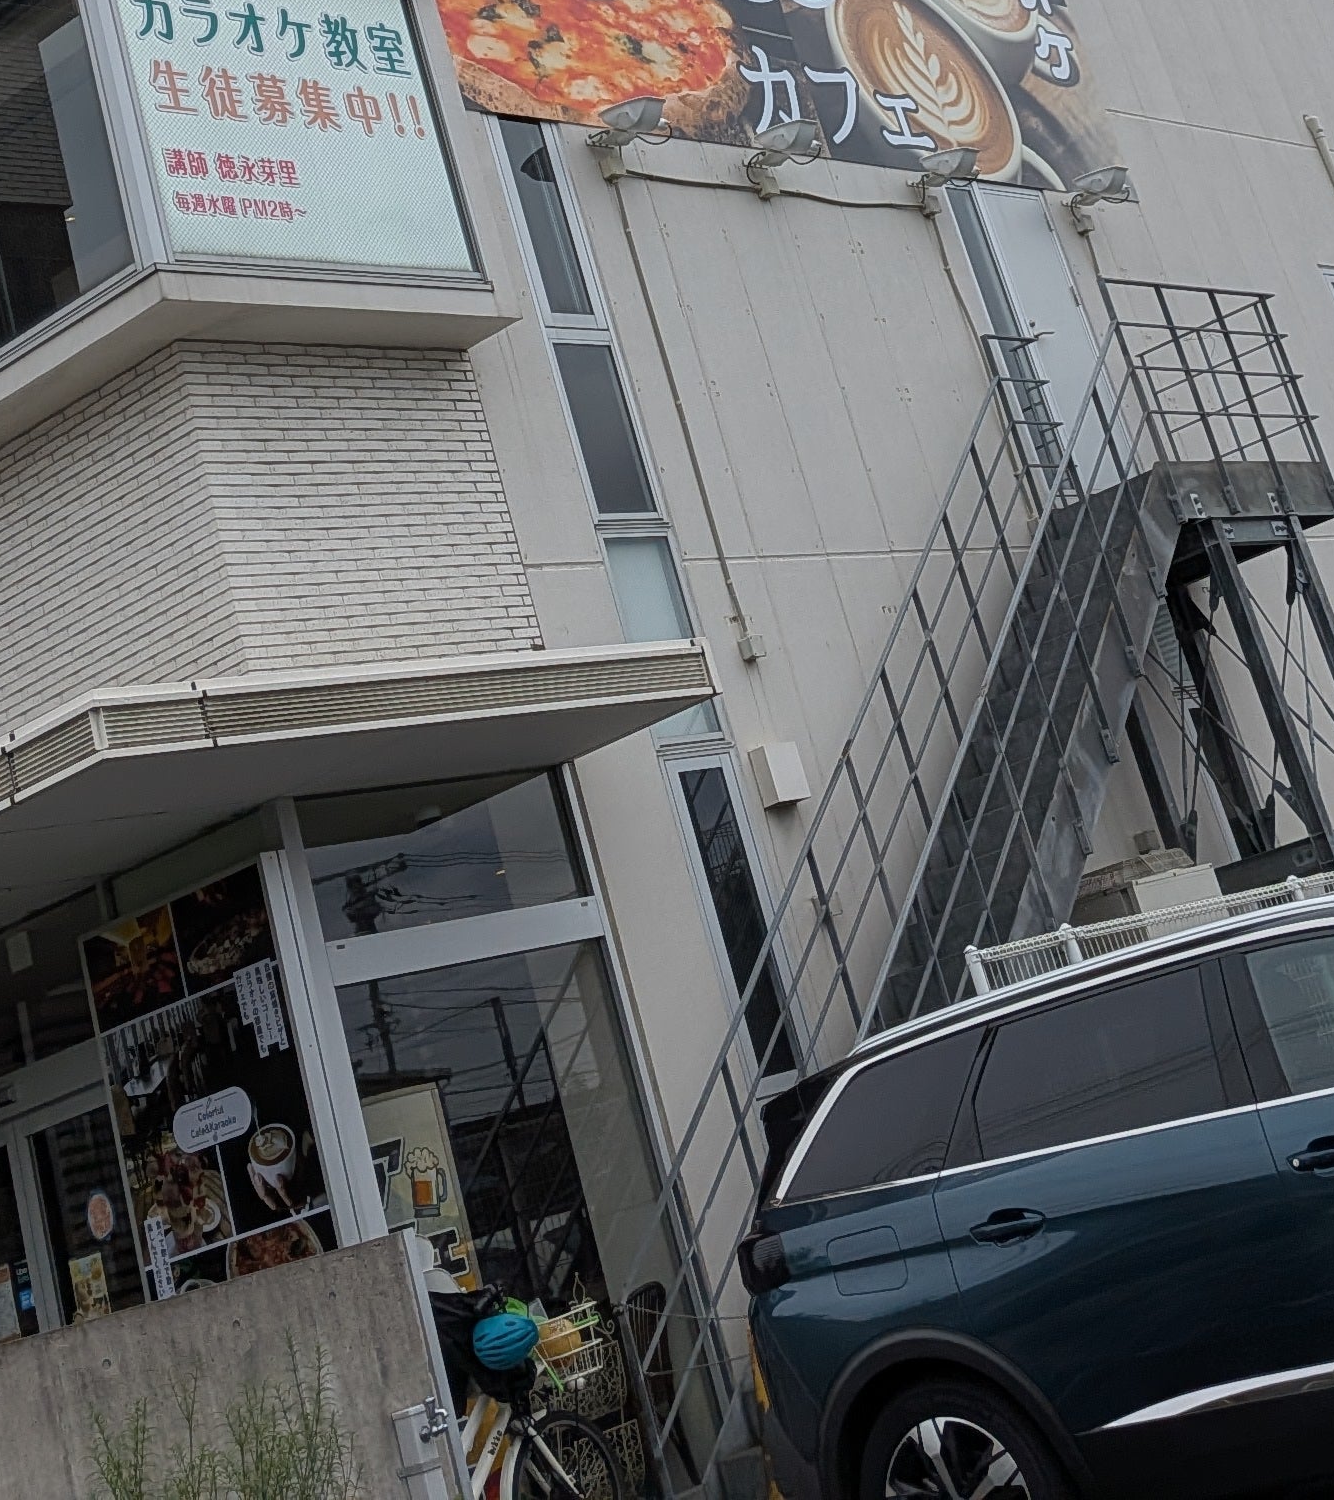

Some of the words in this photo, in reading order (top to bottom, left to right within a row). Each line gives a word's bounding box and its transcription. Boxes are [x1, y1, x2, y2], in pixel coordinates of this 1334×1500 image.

[149, 59, 427, 139] 生徒募集中!!
[738, 43, 938, 152] カフェ
[162, 148, 208, 180] 講師
